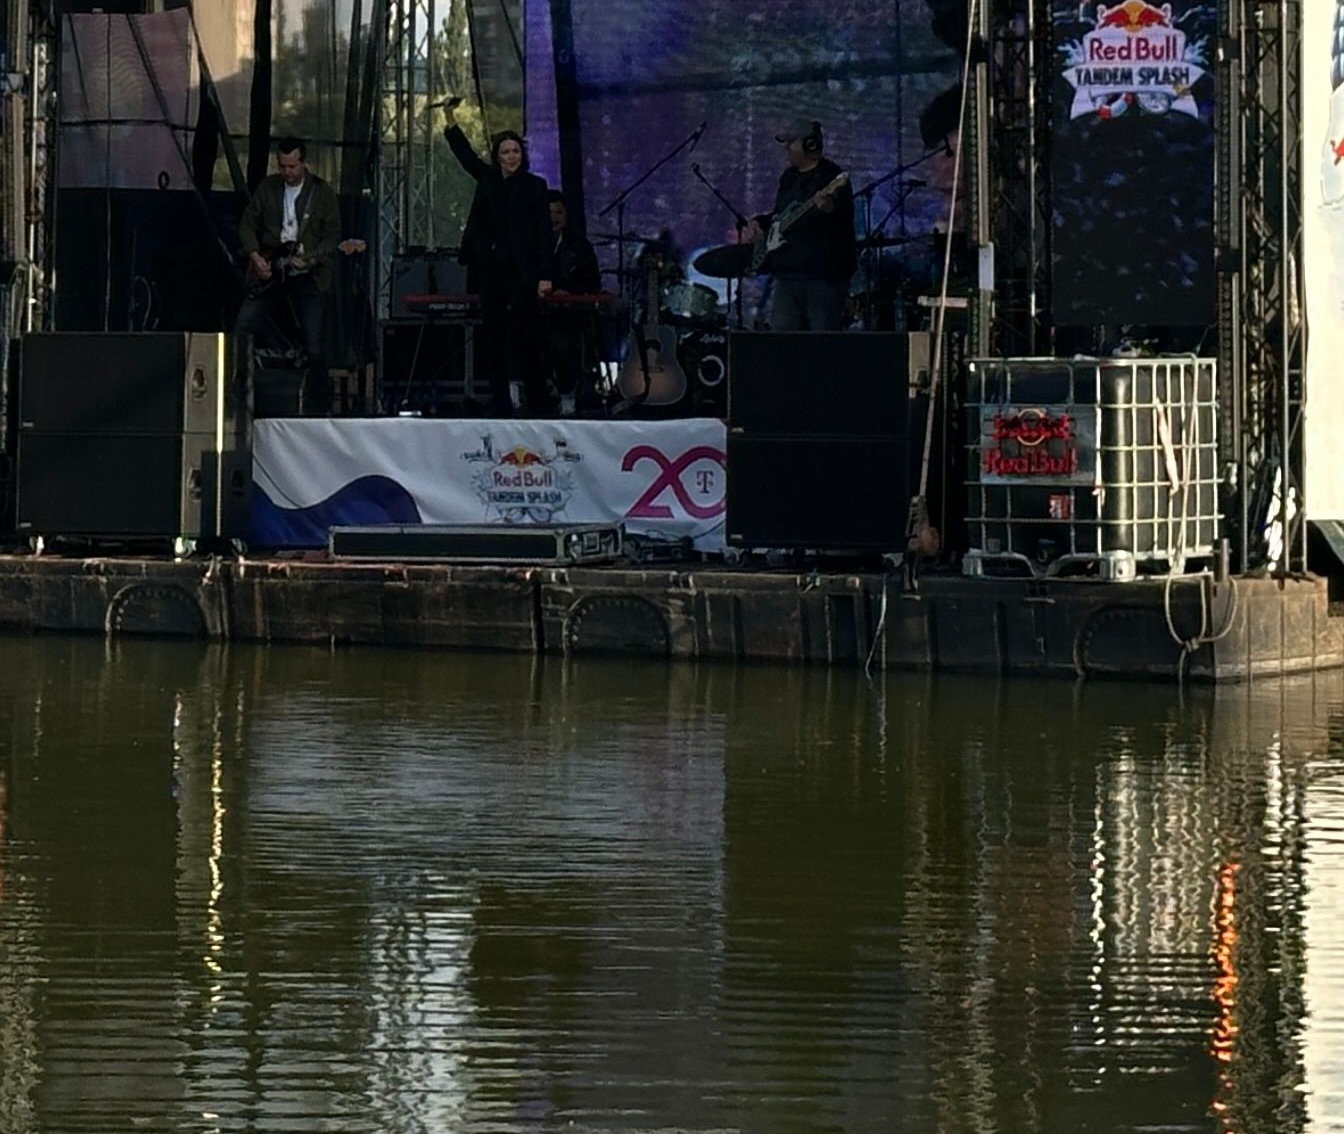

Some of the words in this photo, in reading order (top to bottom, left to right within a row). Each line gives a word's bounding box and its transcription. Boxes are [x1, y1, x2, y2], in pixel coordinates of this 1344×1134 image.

[1089, 36, 1132, 61] Red
[1136, 34, 1178, 61] Bull
[1075, 67, 1134, 86] TANDEM
[1138, 67, 1190, 86] SPLASH
[493, 470, 522, 487] Red
[524, 470, 553, 487] Bull
